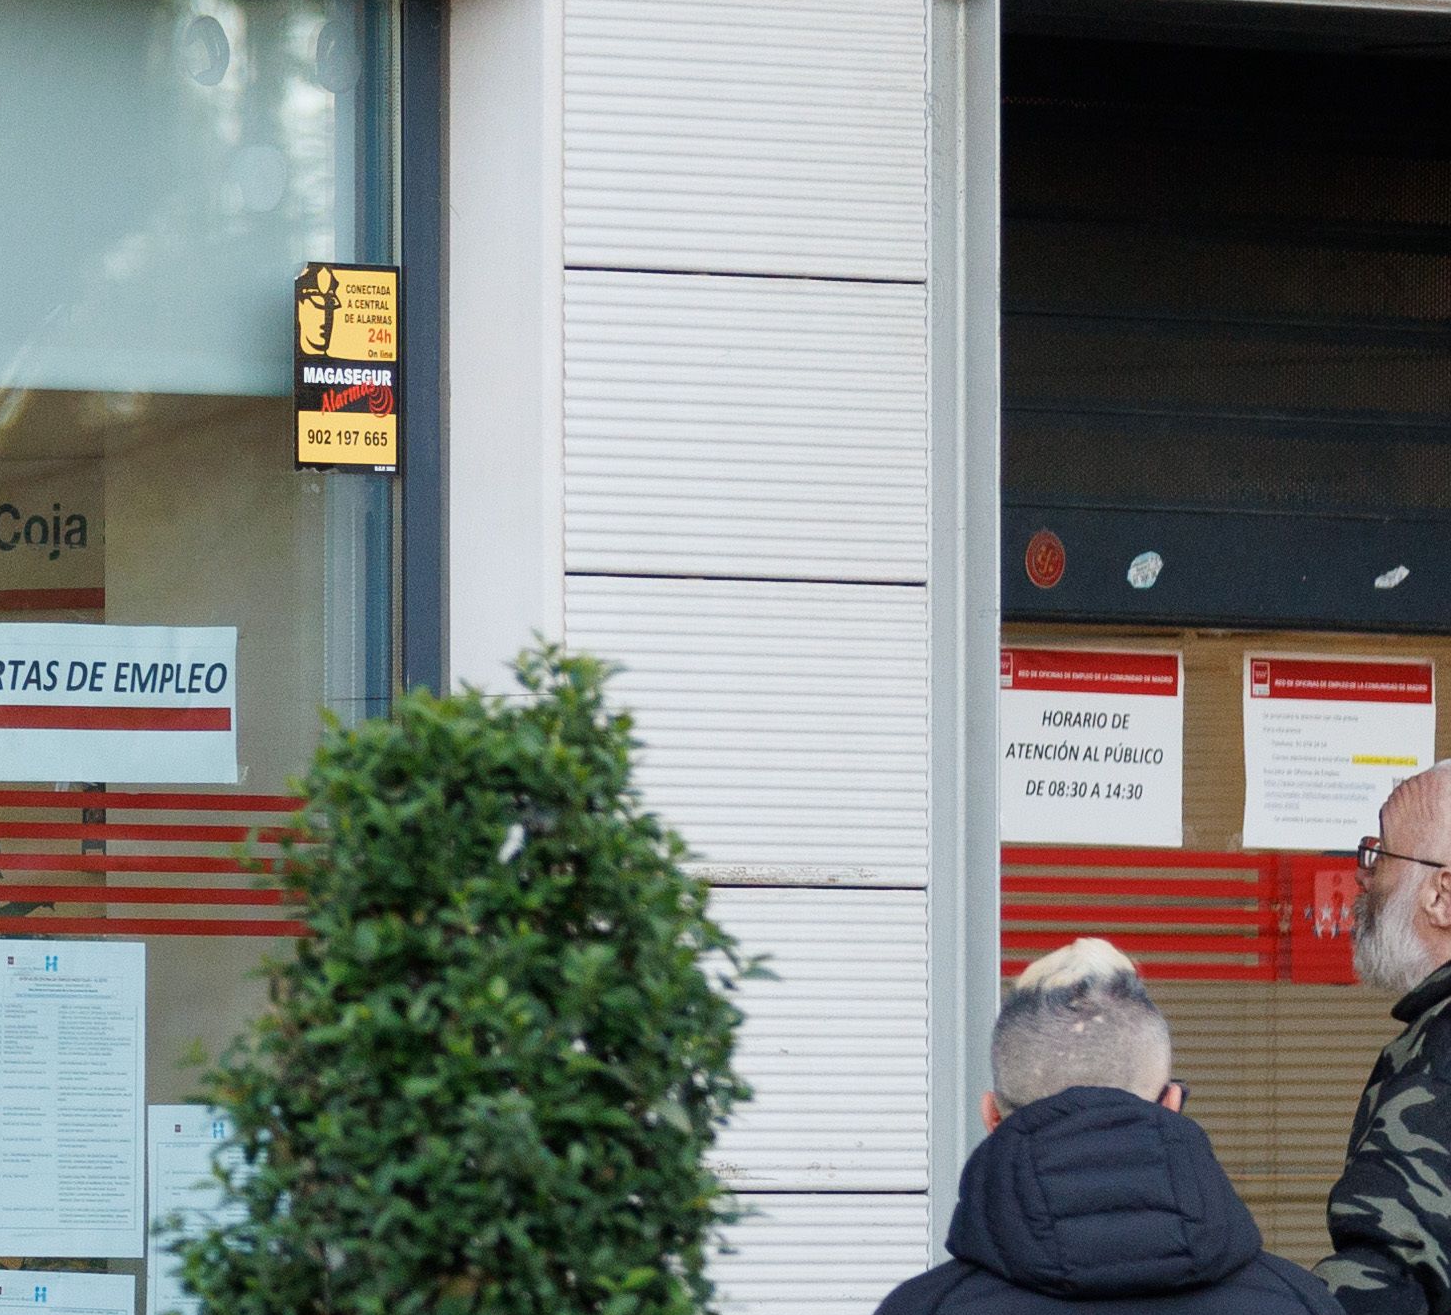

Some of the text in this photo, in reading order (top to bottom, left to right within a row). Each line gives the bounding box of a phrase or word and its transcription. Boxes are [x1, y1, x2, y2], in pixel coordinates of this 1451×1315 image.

[346, 285, 391, 295] CONECTADA
[347, 300, 389, 310] A CENTRAL
[345, 314, 392, 325] DE ALARMAS
[368, 328, 392, 344] 24h
[368, 349, 393, 358] On line
[304, 367, 391, 386] MAGASEGUR
[322, 380, 375, 415] Alarmas
[308, 429, 387, 447] 902 197 665
[66, 661, 106, 692] DE
[113, 661, 227, 695] EMPLEO
[1041, 710, 1130, 730] HORARIO DE
[1005, 740, 1163, 764] ATENCIÓN AL PÚBLICO
[1026, 780, 1143, 799] DE 08:30 A 14:30
